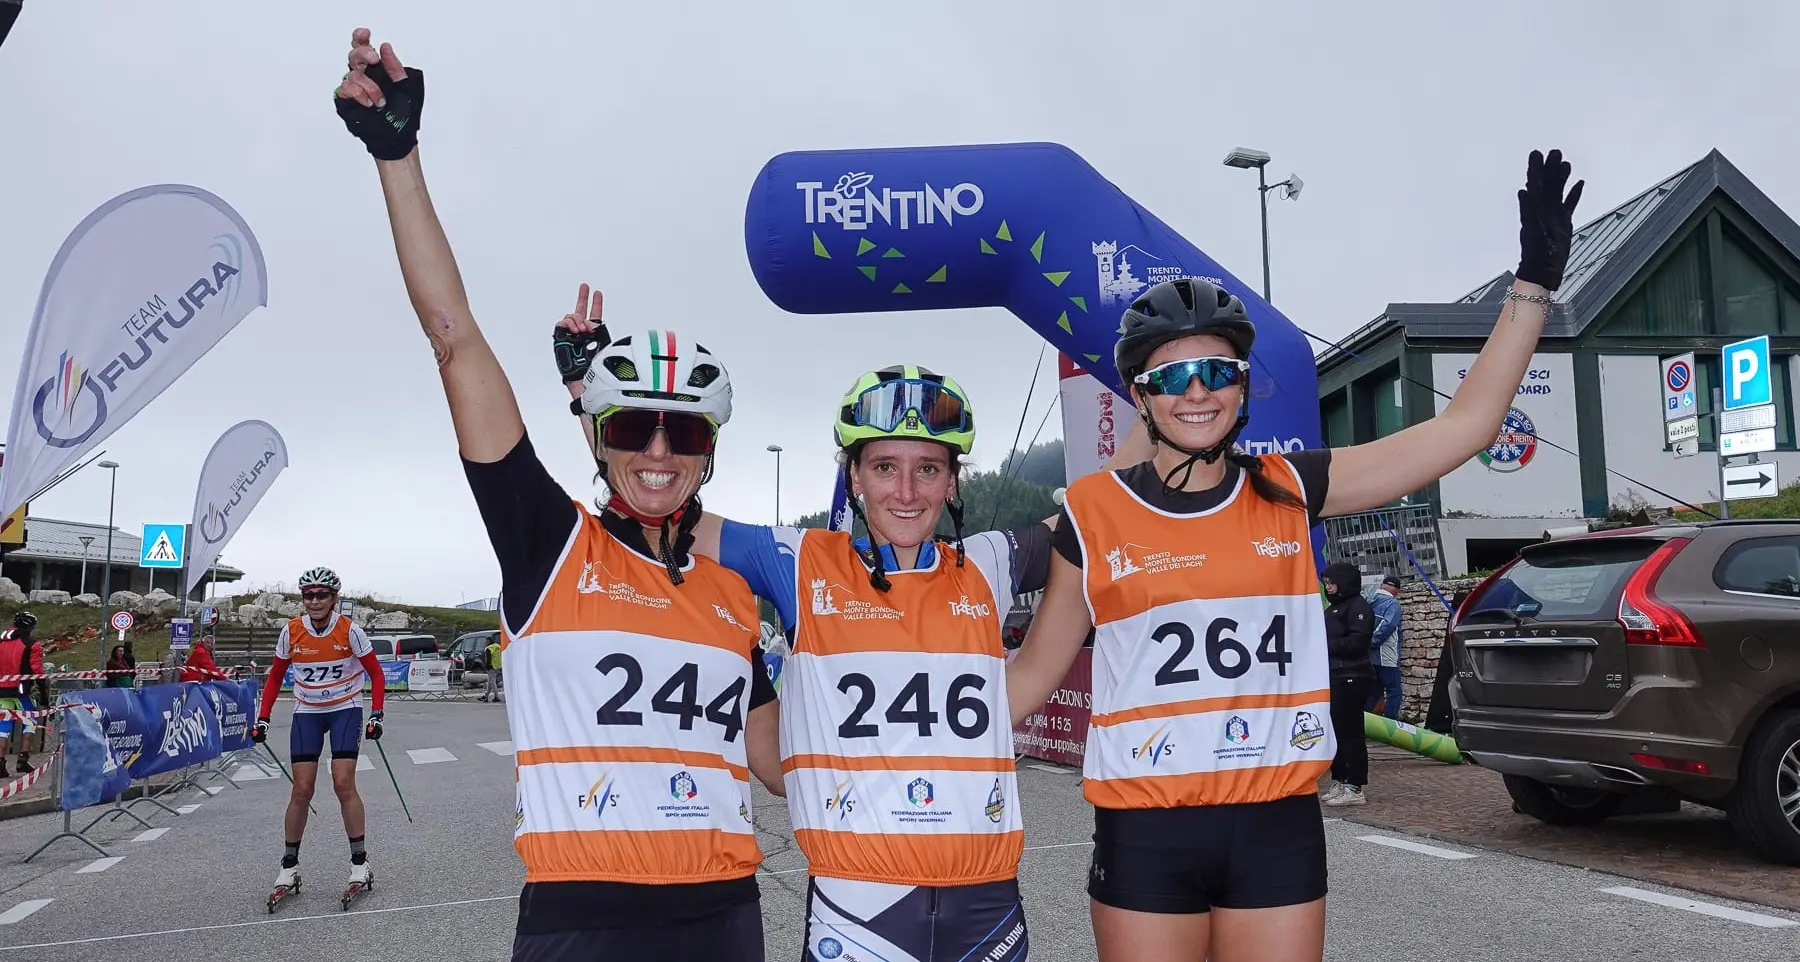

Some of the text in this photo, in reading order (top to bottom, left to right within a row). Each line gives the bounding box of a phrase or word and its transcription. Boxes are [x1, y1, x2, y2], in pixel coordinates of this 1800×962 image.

[796, 181, 984, 230] TRENTINO
[1147, 266, 1182, 275] TRENTO
[121, 293, 167, 337] TEAM
[97, 261, 240, 393] FUTURA
[1528, 369, 1550, 380] SCI
[1732, 349, 1758, 400] P
[223, 450, 276, 517] FUTURA
[229, 470, 247, 491] TEAM
[1143, 551, 1171, 562] TRENTO
[1251, 541, 1301, 558] TRENTINO
[1144, 554, 1207, 568] MONTE BONDONE
[1146, 565, 1169, 575] VALLE
[1181, 560, 1203, 568] LAGHI
[608, 582, 635, 592] TRENTO
[608, 589, 672, 605] MONTE BONDONE
[609, 595, 632, 603] VALLE
[632, 597, 645, 606] DEI
[843, 612, 864, 621] VALLE
[878, 613, 900, 621] LAGHI
[870, 607, 905, 617] BONDONE
[1484, 629, 1558, 637] VOLVO
[1150, 614, 1292, 687] 264
[302, 664, 344, 682] 275
[594, 653, 747, 742] 244
[836, 672, 990, 739] 246
[1047, 688, 1084, 709] AZIONI
[989, 922, 1025, 961] HOLDING
